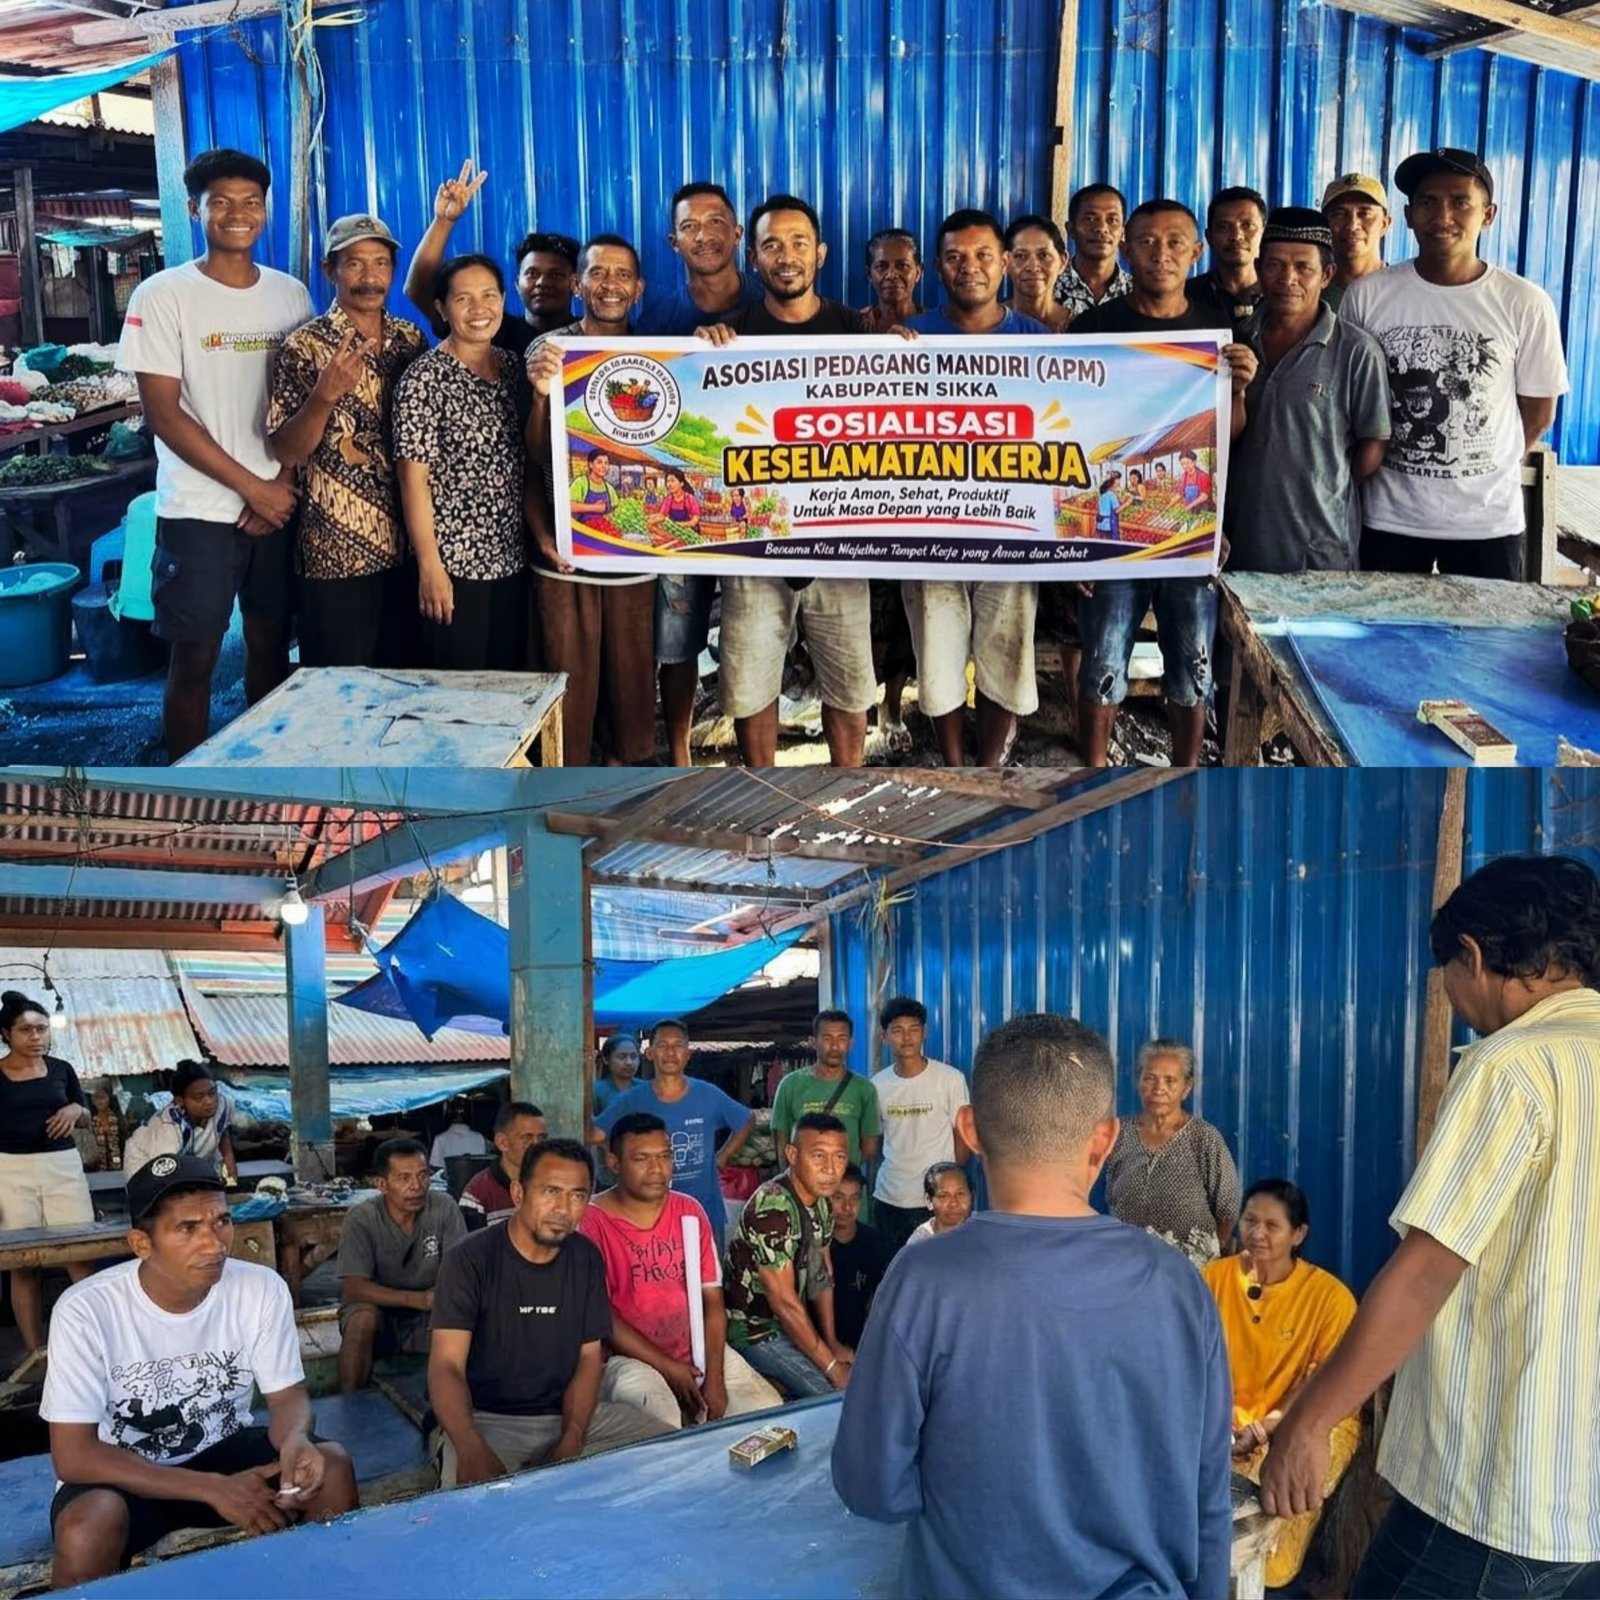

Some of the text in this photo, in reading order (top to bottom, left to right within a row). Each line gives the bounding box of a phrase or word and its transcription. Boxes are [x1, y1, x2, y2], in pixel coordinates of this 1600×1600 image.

[702, 357, 806, 390] ASOSIASI
[814, 353, 930, 378] PEDAGANG
[936, 353, 1030, 378] MANDIRI
[1036, 355, 1106, 388] (APM)
[806, 381, 998, 399] KABUPATEN SIKKA
[794, 411, 1016, 439] SOSIALISASI
[726, 443, 1088, 485] KESELAMATAN KERJA
[809, 487, 847, 504] Kerja
[899, 487, 943, 502] Sehat,
[947, 488, 1010, 503] Produktif
[793, 503, 1036, 520] Untuk Masa Depan yang Lebih Baik
